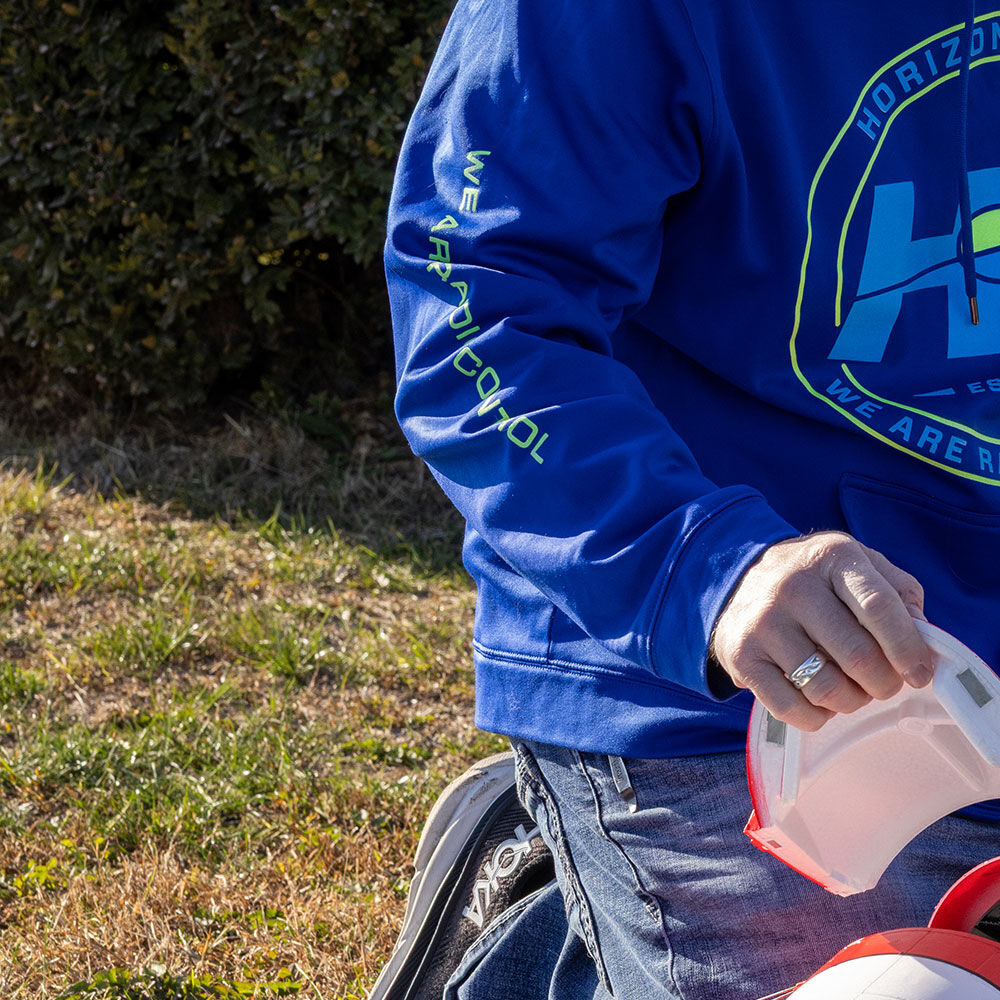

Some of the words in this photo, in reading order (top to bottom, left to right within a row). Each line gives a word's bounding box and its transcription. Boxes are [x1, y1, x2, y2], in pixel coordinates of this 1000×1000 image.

[459, 150, 492, 213] WE
[825, 378, 883, 420] WE
[888, 415, 967, 464] ARE
